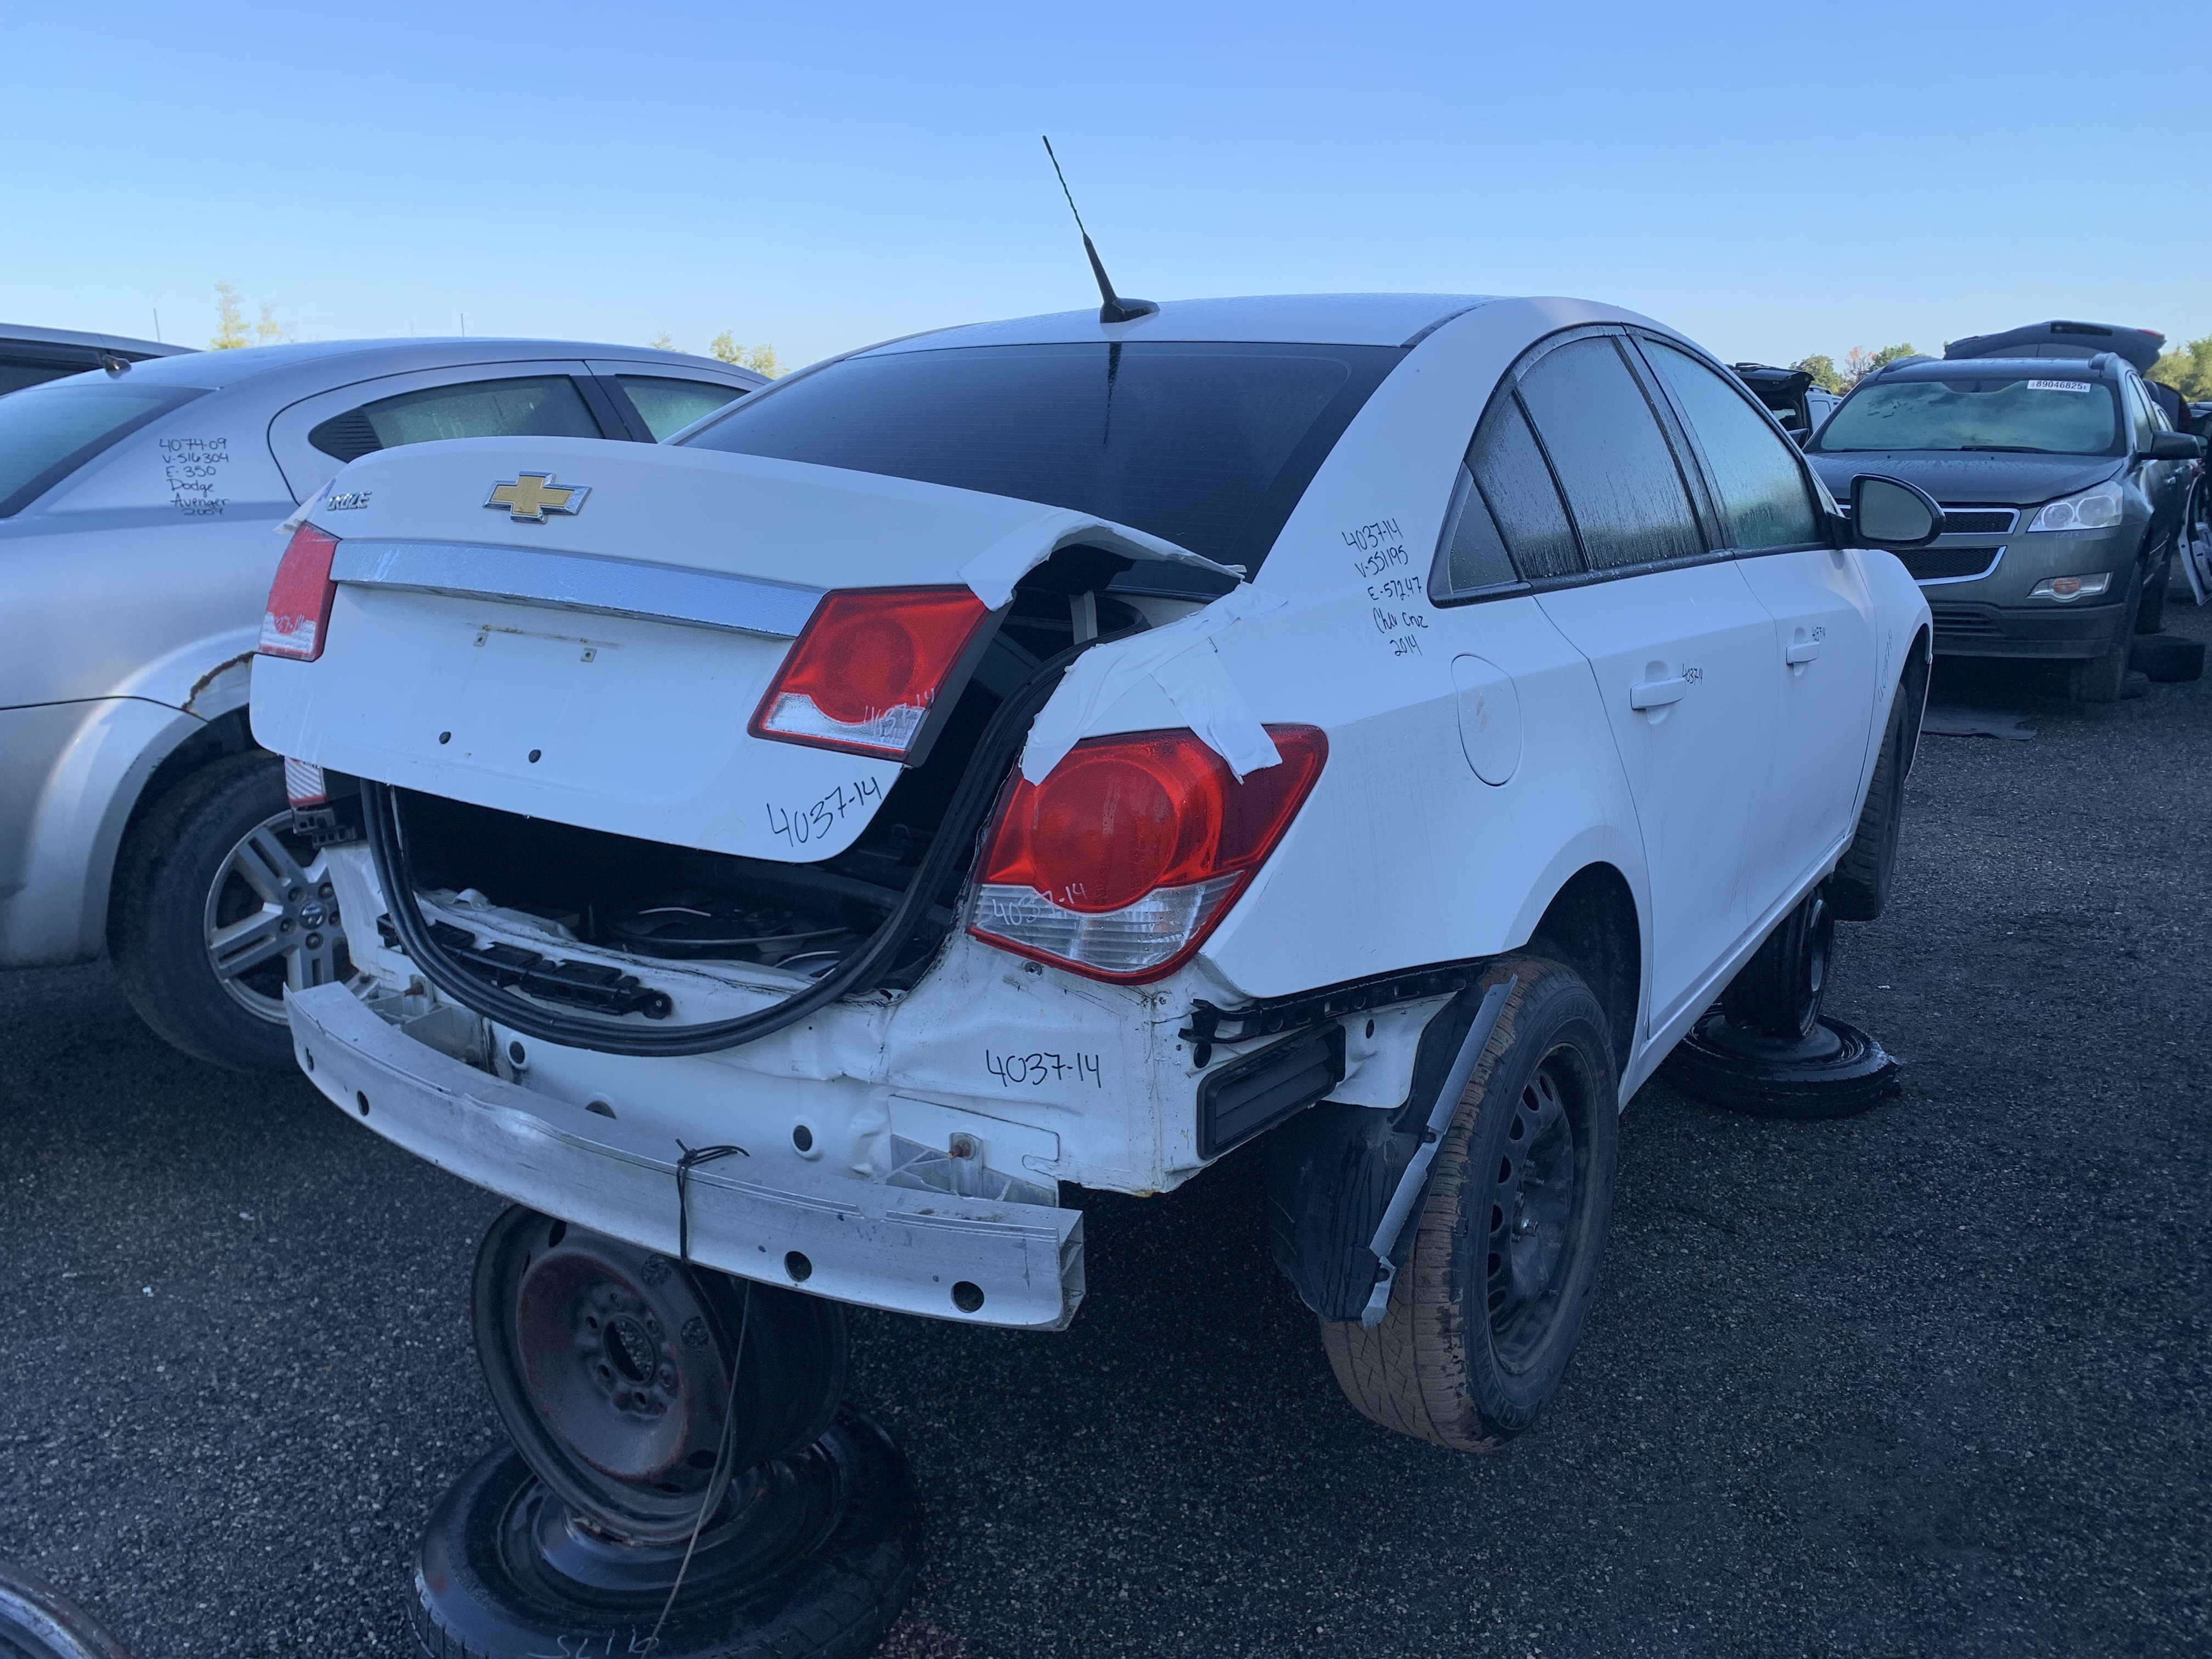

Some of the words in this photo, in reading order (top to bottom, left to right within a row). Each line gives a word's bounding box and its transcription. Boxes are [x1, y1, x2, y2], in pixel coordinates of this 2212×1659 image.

[2036, 380, 2083, 390] 89046825
[159, 437, 227, 452] 4074-09
[162, 452, 229, 464] V-516304
[166, 478, 214, 498] Dodge
[170, 492, 230, 510] Avenger
[326, 491, 372, 511] CRUZE
[1341, 518, 1404, 552] 4037-14
[1354, 545, 1409, 578] V-551195
[1389, 634, 1423, 657] 2014
[766, 776, 883, 848] 4037-14
[990, 882, 1088, 926] 4037-14
[986, 1049, 1102, 1089] 4037-14
